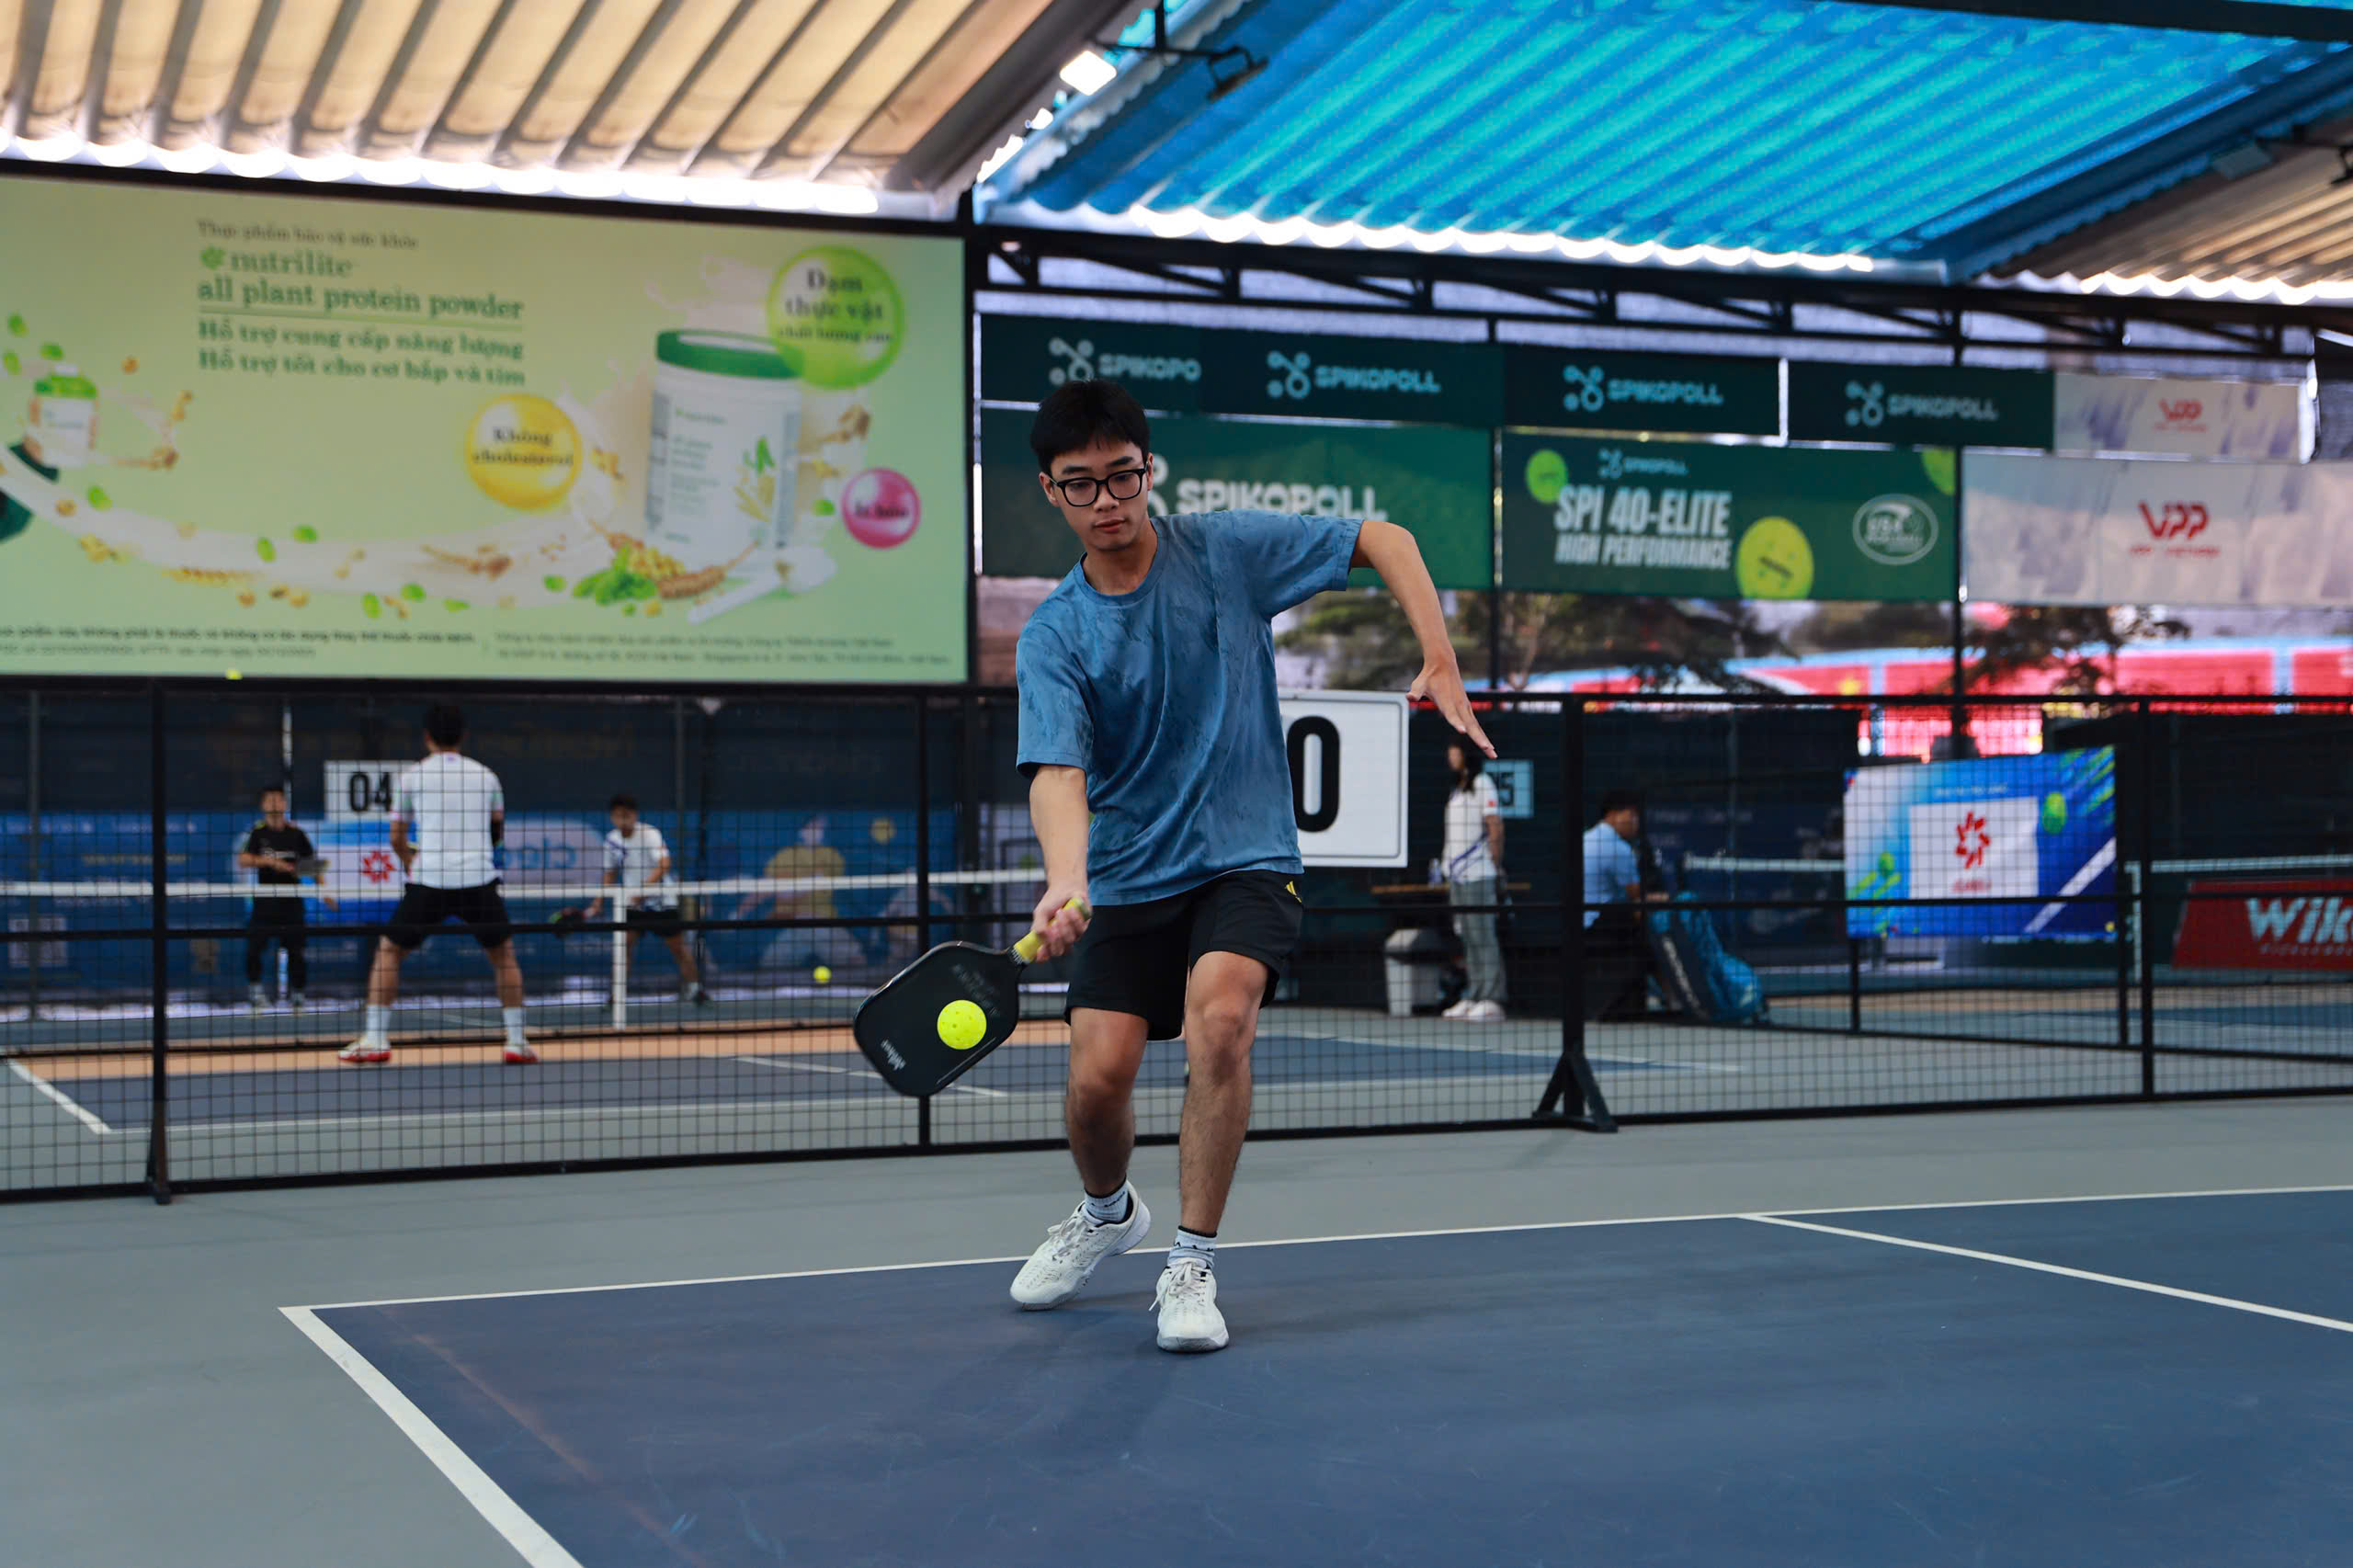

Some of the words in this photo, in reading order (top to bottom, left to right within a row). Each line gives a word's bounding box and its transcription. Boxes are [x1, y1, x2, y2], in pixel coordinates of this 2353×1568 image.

[198, 274, 233, 301] all
[242, 277, 315, 308] plant
[324, 284, 420, 314] protein
[428, 291, 525, 320] powder
[1176, 478, 1388, 522] SPIKOPOLL
[1553, 483, 1605, 531] SPI
[1608, 486, 1733, 537] 40-ELITE
[1554, 532, 1601, 566] HIGH
[1602, 535, 1733, 570] PERFORMANCE
[2245, 896, 2353, 944] Wik
